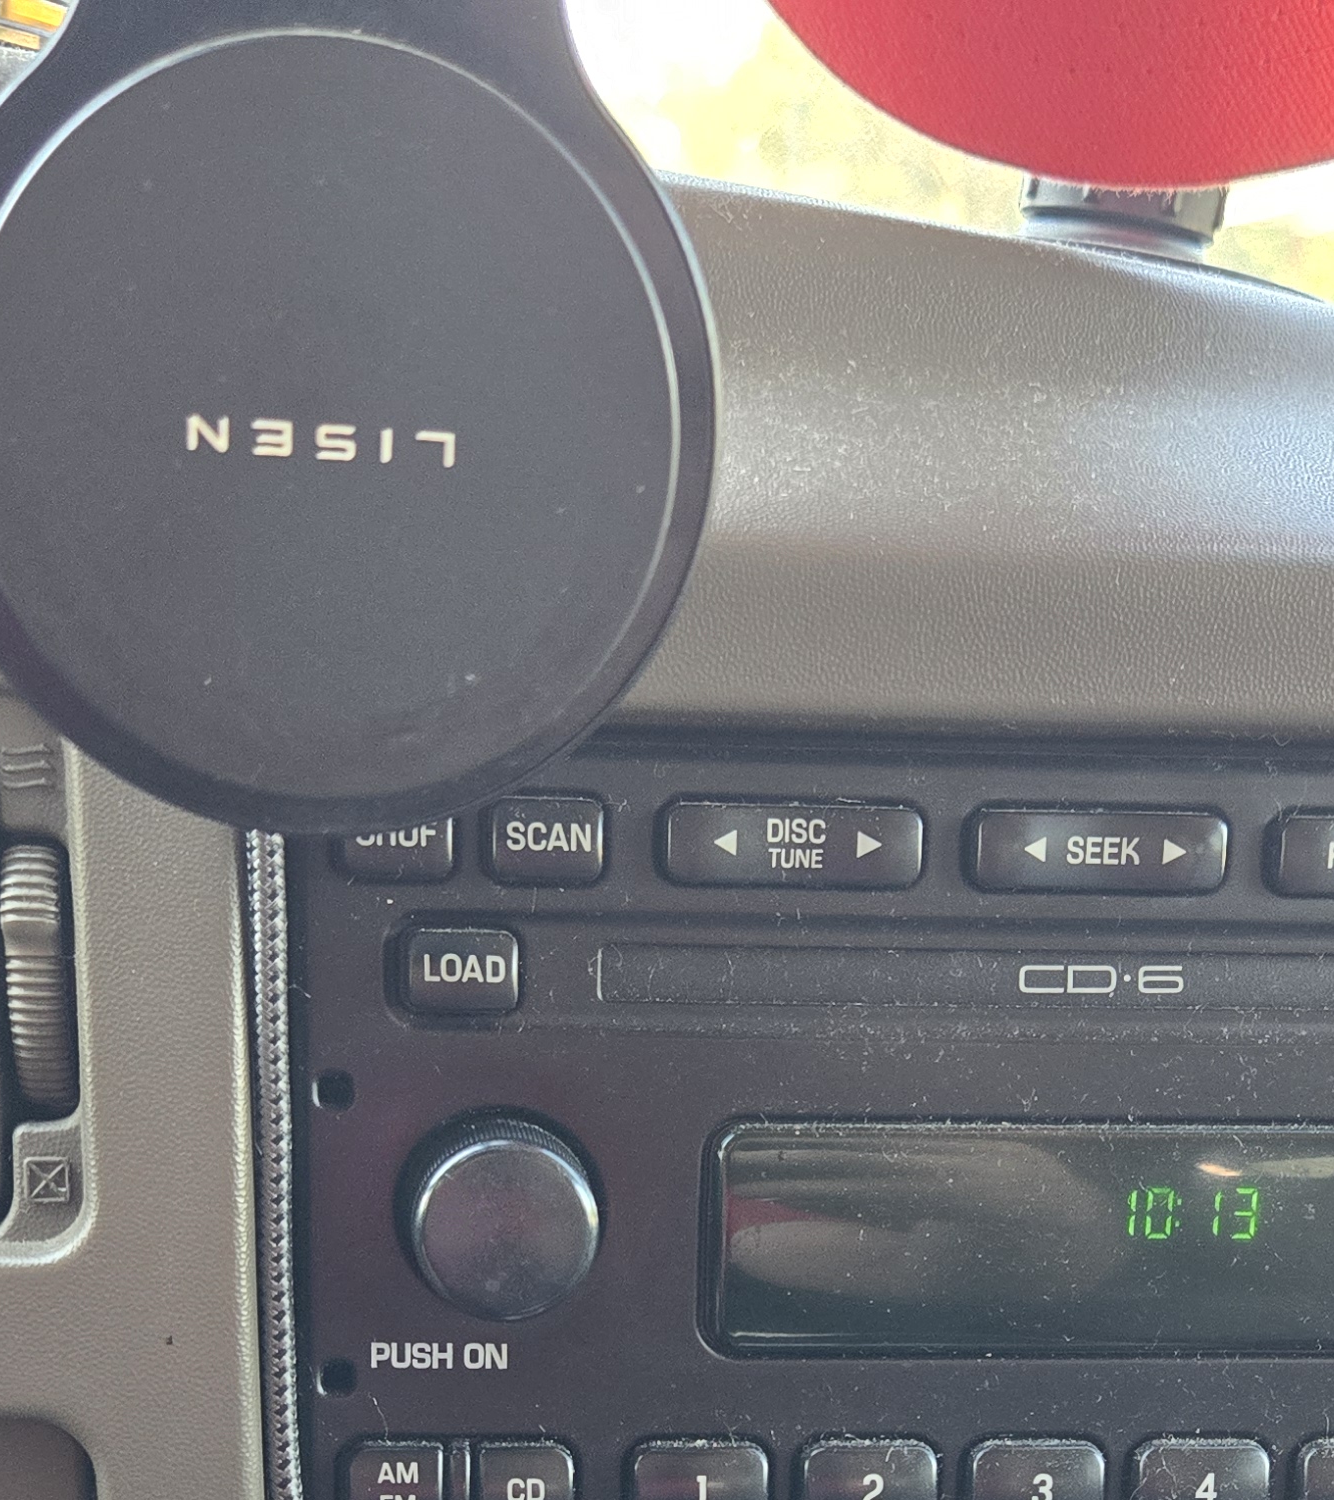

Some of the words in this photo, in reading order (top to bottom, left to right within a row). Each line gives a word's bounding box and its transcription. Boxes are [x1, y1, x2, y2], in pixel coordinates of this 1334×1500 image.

[183, 411, 458, 470] LISEN
[504, 818, 593, 854] SCAN
[765, 816, 829, 846] DISC
[767, 847, 825, 871] TUNE
[1065, 834, 1142, 867] SEEK
[421, 952, 508, 986] LOAD
[1125, 1186, 1260, 1241] 10:13
[369, 1341, 454, 1370] PUSH
[462, 1342, 510, 1371] ON
[376, 1461, 420, 1485] AM
